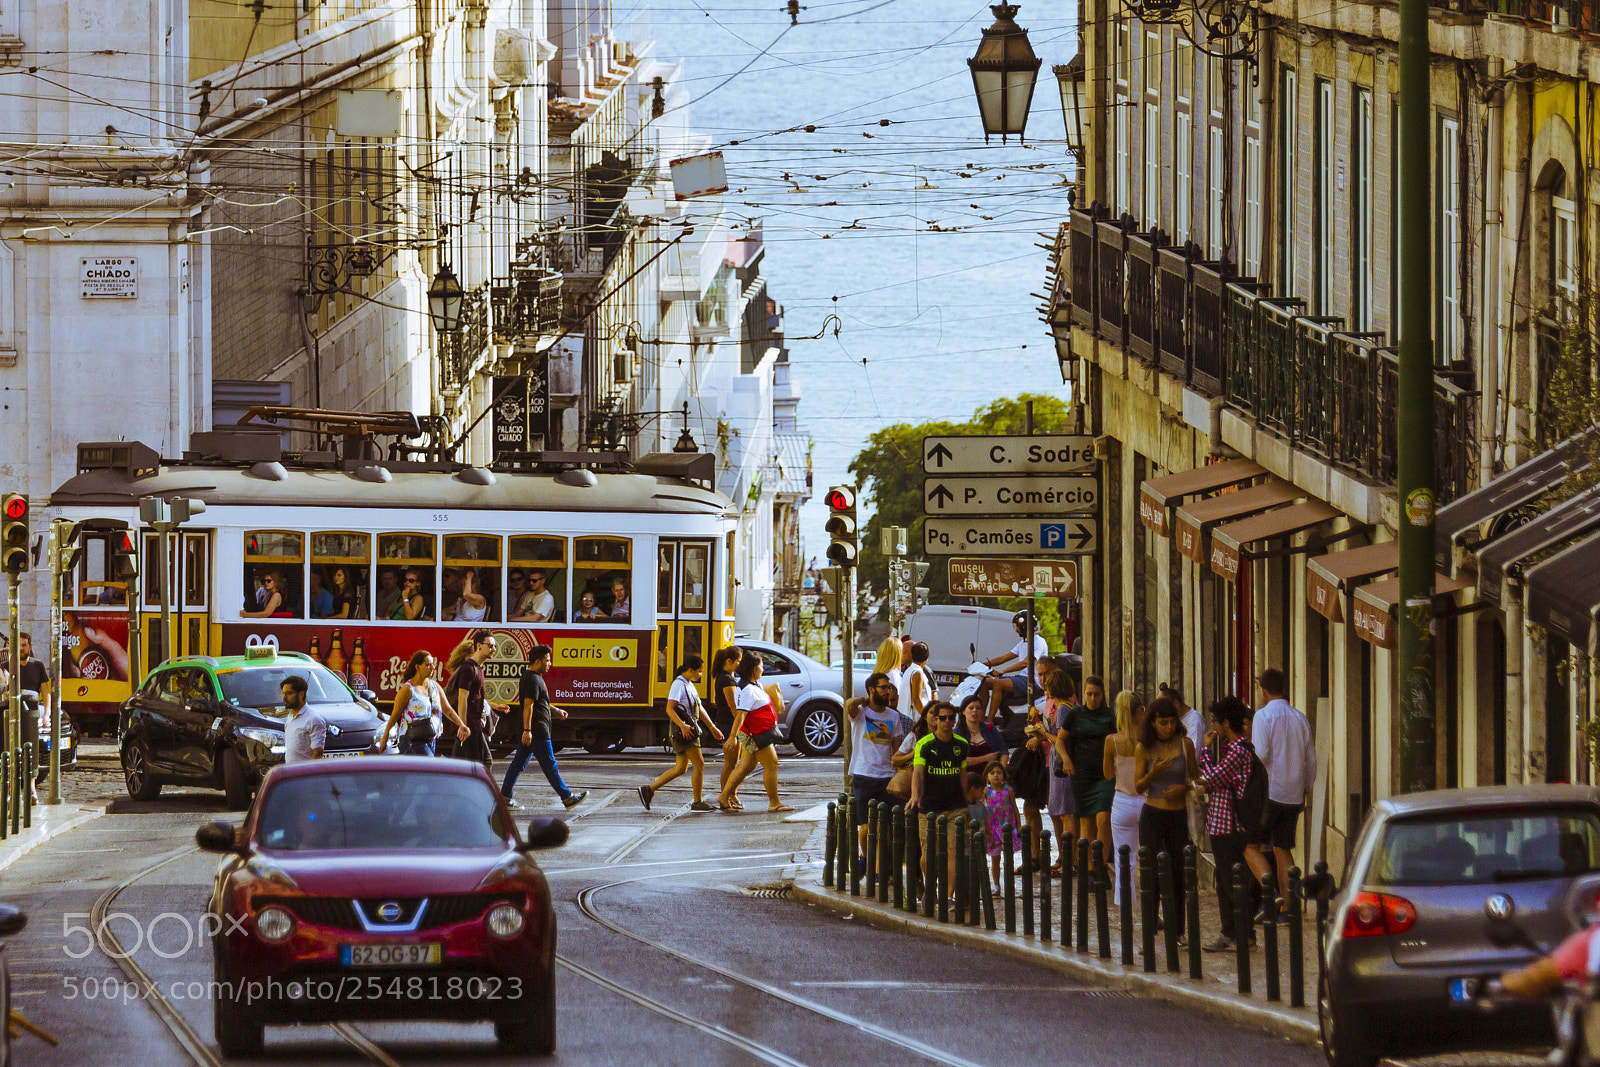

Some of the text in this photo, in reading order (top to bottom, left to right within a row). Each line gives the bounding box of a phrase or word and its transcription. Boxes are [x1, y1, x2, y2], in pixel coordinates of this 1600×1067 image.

[86, 270, 131, 278] CHIADO
[498, 433, 523, 442] CHIADO
[989, 444, 1093, 463] C. Sodré
[964, 487, 1095, 504] P. Comércio
[432, 513, 449, 522] 555
[928, 529, 954, 546] Pq.
[965, 528, 1034, 544] Camões
[951, 563, 984, 573] museu
[561, 644, 602, 658] carris
[82, 656, 103, 676] SUPER
[502, 664, 529, 677] BOC
[573, 679, 589, 689] Seja
[555, 689, 574, 698] Beba
